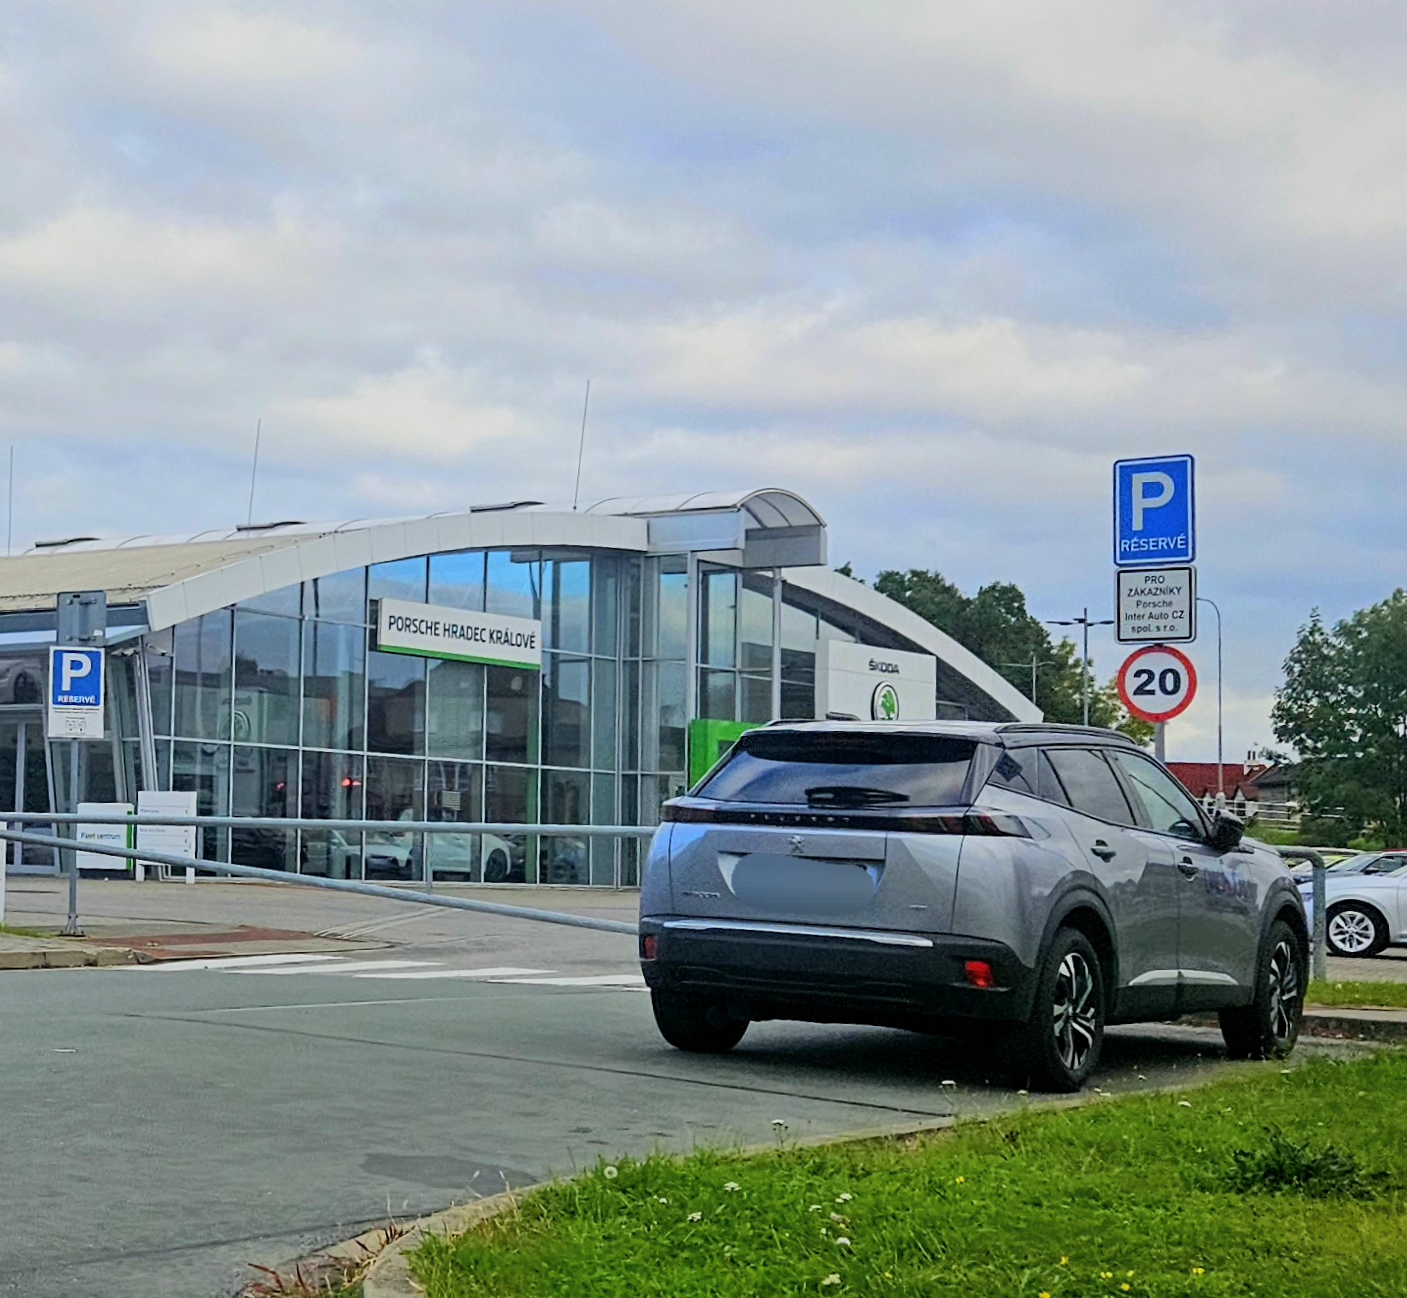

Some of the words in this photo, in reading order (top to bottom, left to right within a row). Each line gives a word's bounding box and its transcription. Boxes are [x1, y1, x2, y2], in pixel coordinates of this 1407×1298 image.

[1131, 471, 1175, 532] P
[1120, 532, 1187, 553] RÉSERVÉ
[1144, 574, 1166, 585] PRO
[1126, 585, 1183, 598] ZÁKAZNÍKY
[1136, 599, 1174, 609] Porsche
[1124, 612, 1146, 621] Inter
[1147, 611, 1170, 621] Auto
[1171, 609, 1185, 620] CZ
[388, 614, 441, 637] PORSCHE
[442, 622, 487, 644] HRADEC
[488, 627, 537, 650] KRÁLOVÉ
[1130, 623, 1154, 634] spol.
[1155, 624, 1162, 632] s
[1163, 623, 1179, 632] r.o.
[61, 652, 92, 692] P
[1132, 667, 1182, 697] 20
